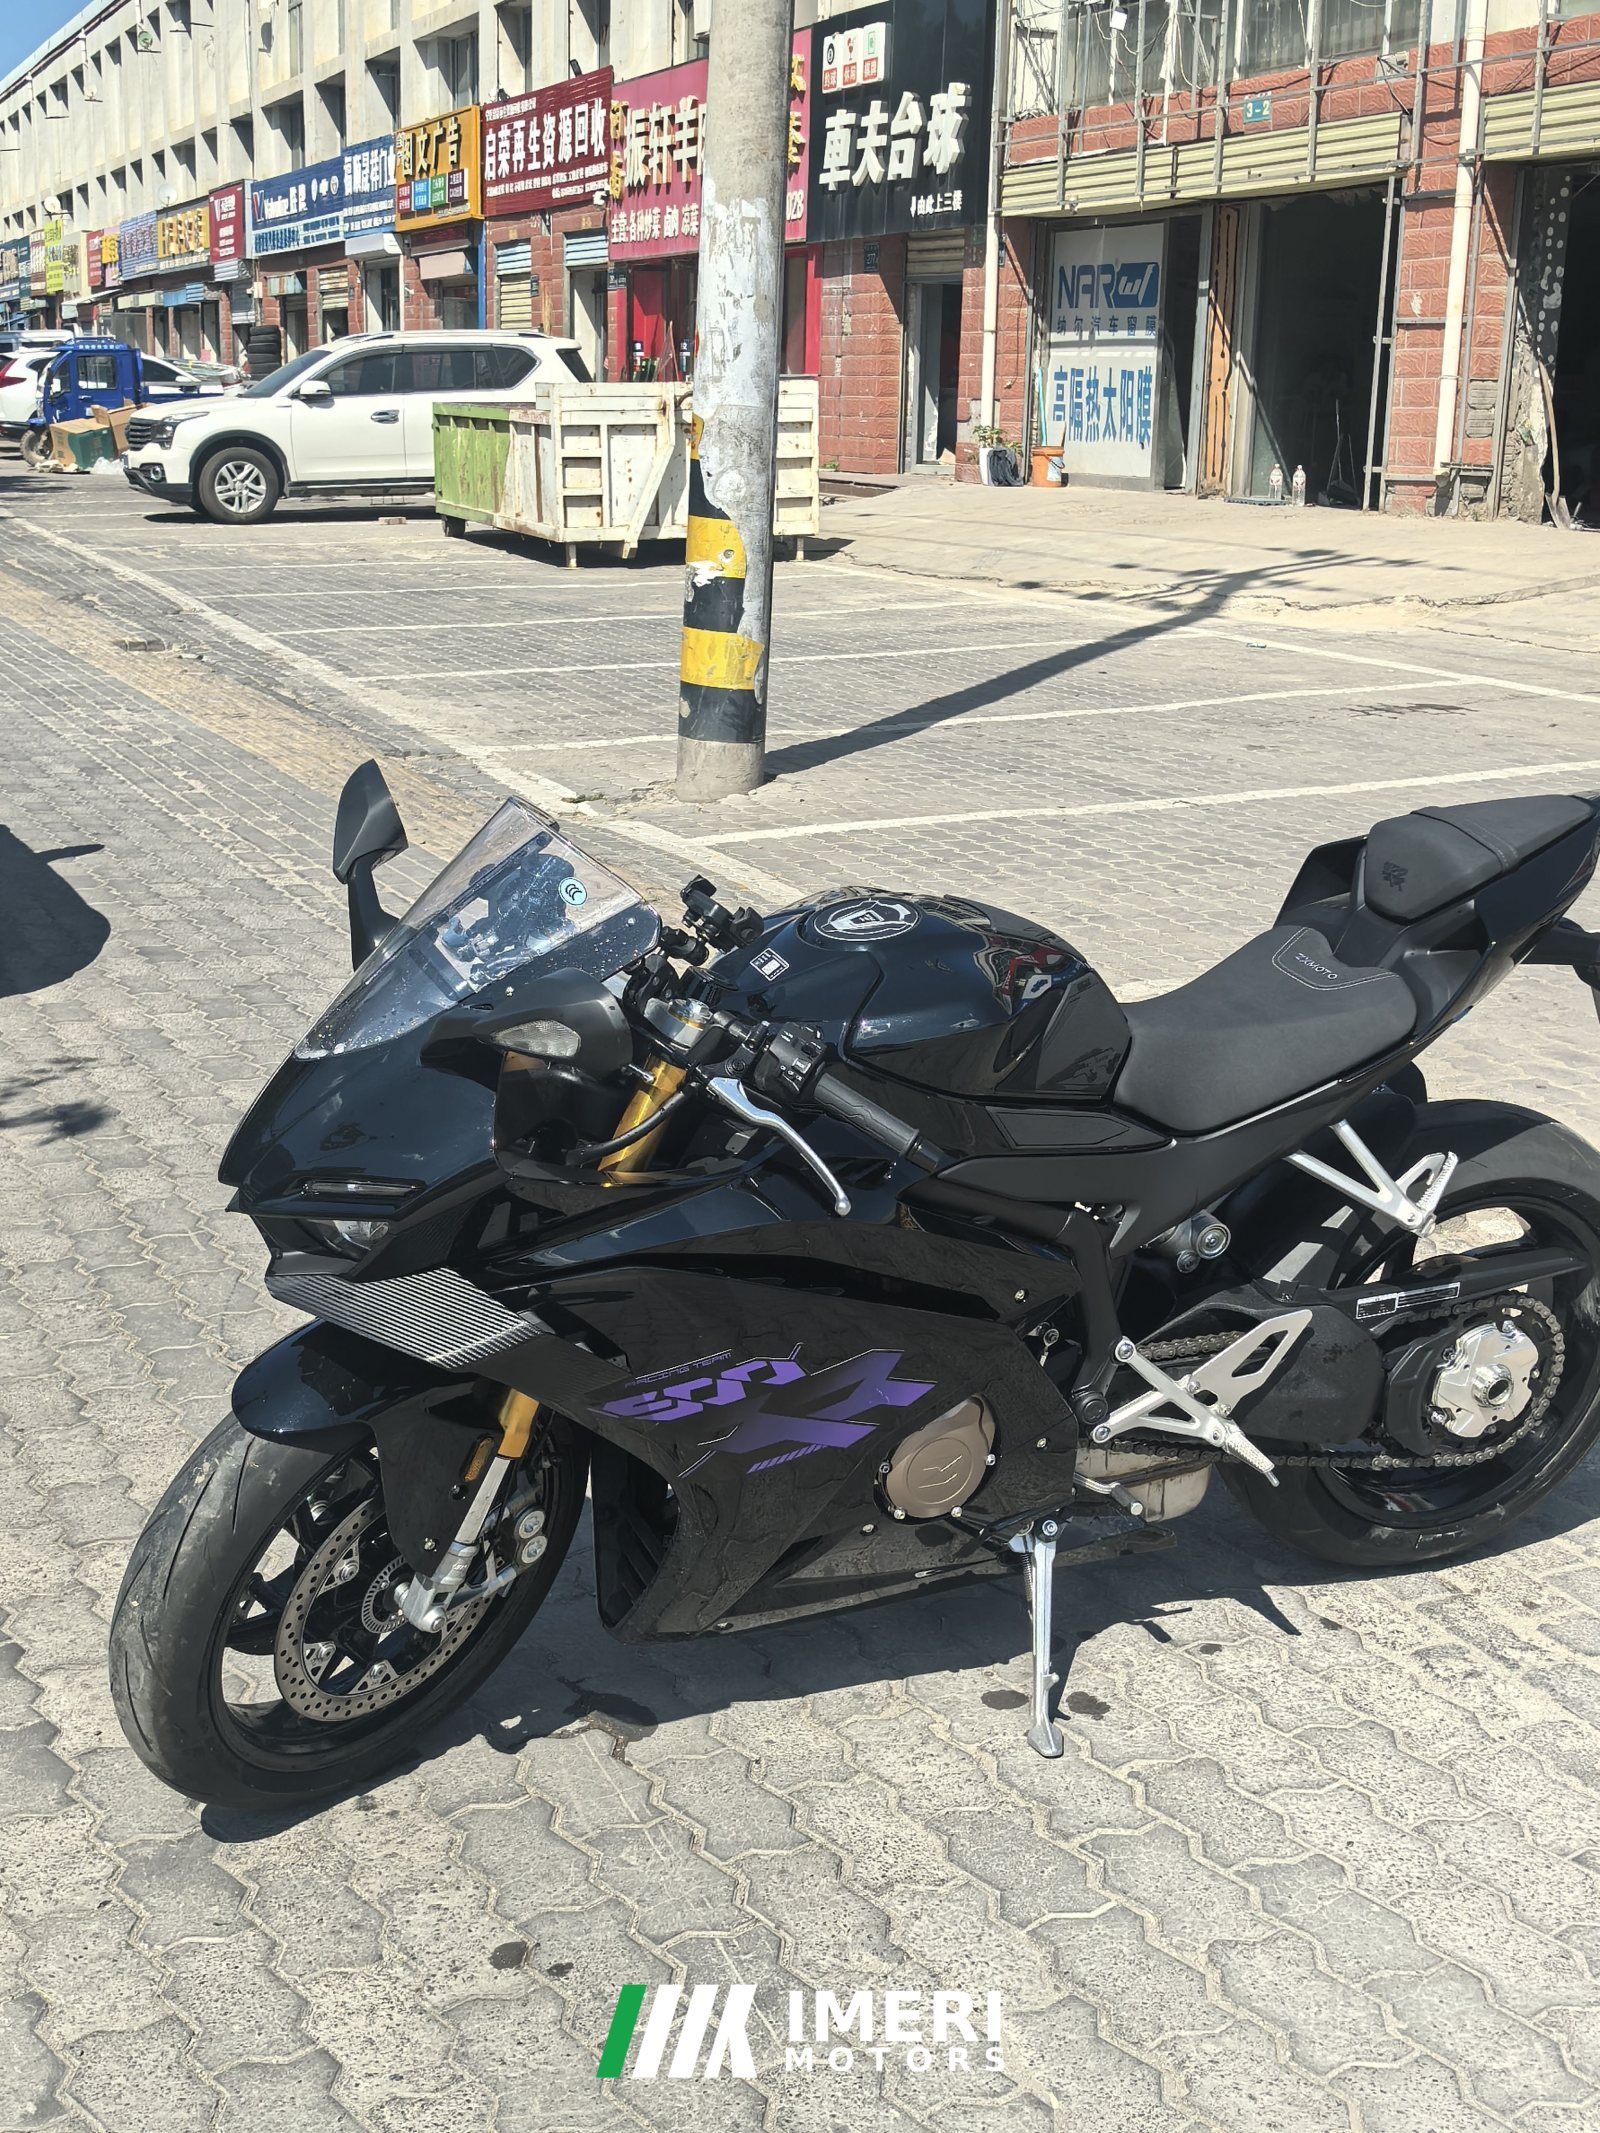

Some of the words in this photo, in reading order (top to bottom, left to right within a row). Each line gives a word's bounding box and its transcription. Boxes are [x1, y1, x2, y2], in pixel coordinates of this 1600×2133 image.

[402, 116, 460, 177] 图文广告
[624, 95, 708, 188] 振轩羊
[819, 82, 969, 191] 車夫台球
[1056, 315, 1158, 337] 纳尔汽车窗膜
[1053, 365, 1153, 447] 高隔热太阳膜
[1295, 952, 1338, 980] ZXMOTO
